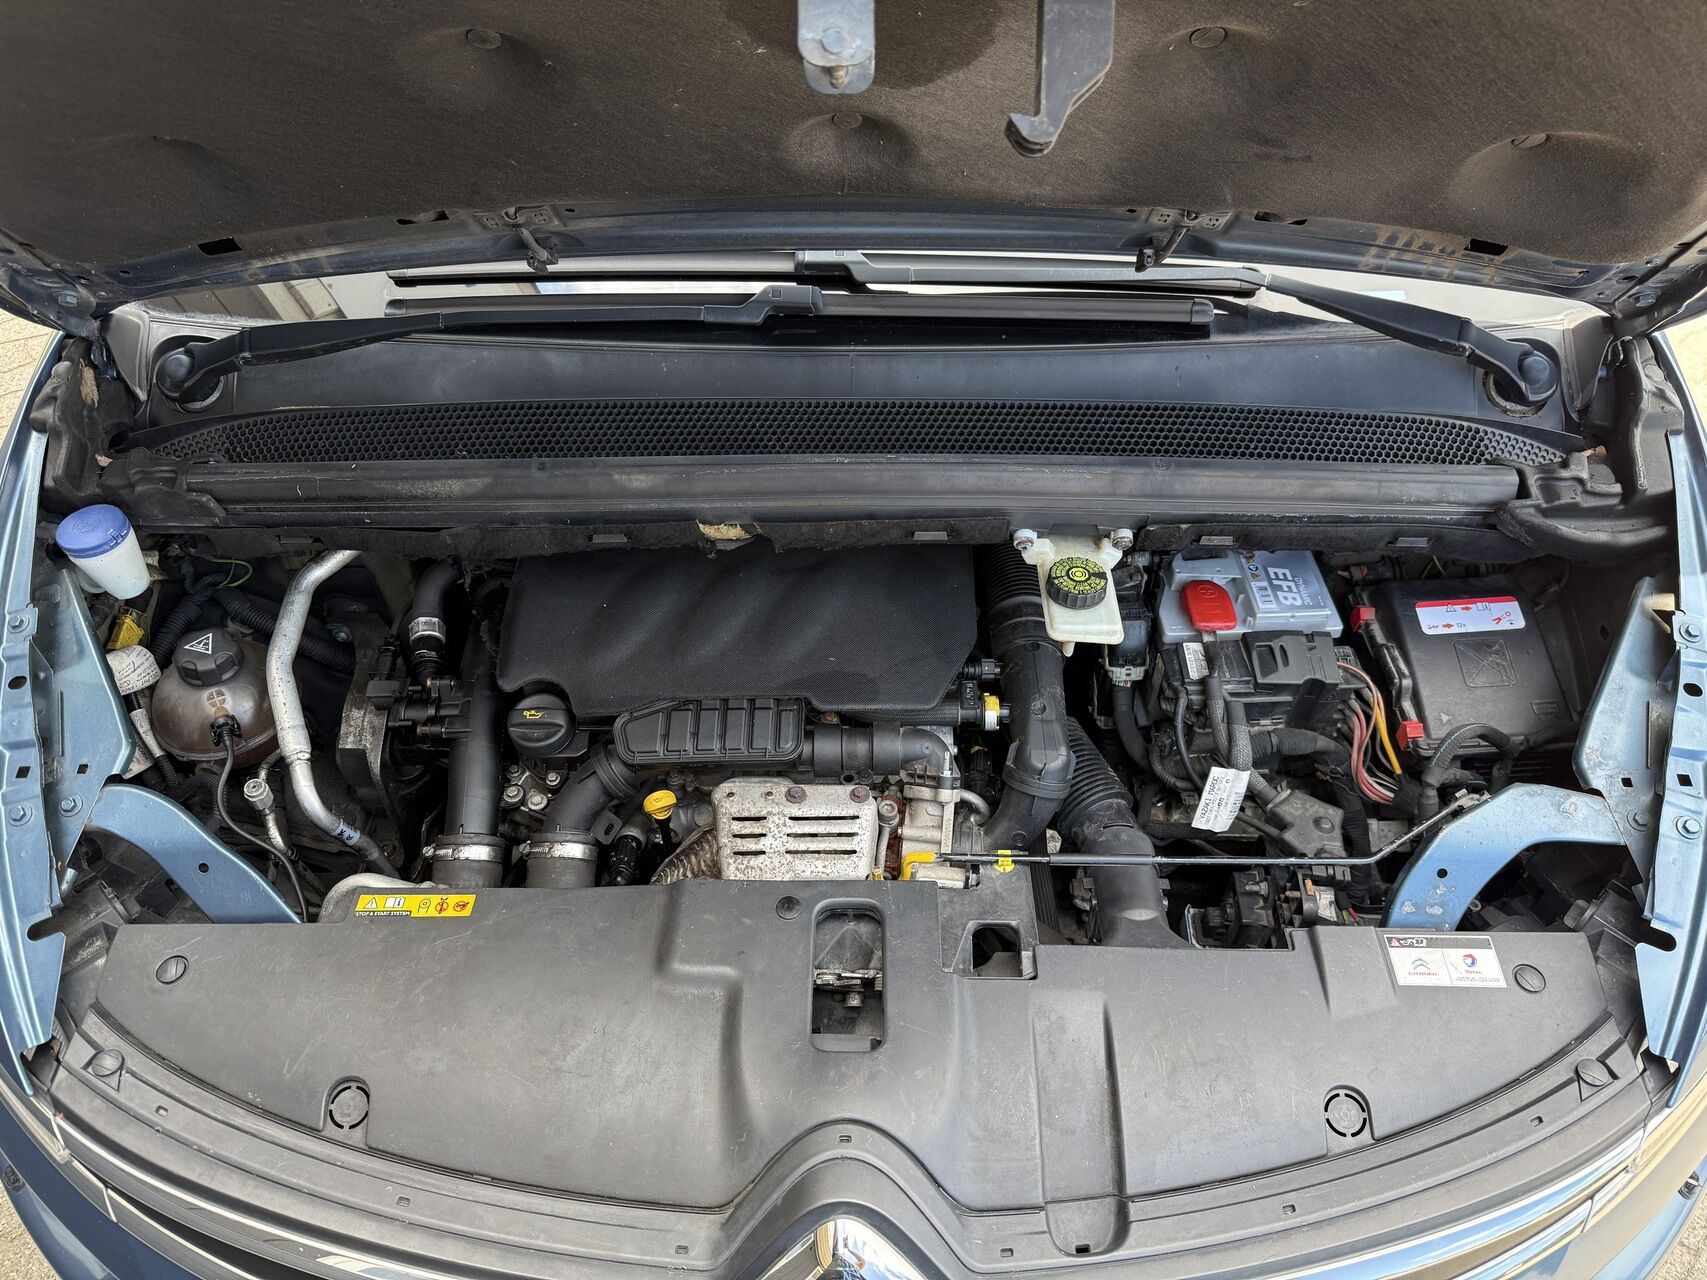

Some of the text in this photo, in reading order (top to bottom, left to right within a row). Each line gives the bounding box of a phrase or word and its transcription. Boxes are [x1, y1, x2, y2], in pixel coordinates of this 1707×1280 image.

[1267, 567, 1302, 606] EFB
[1294, 577, 1313, 606] DYNAMIC
[1200, 798, 1211, 819] YAZAKI
